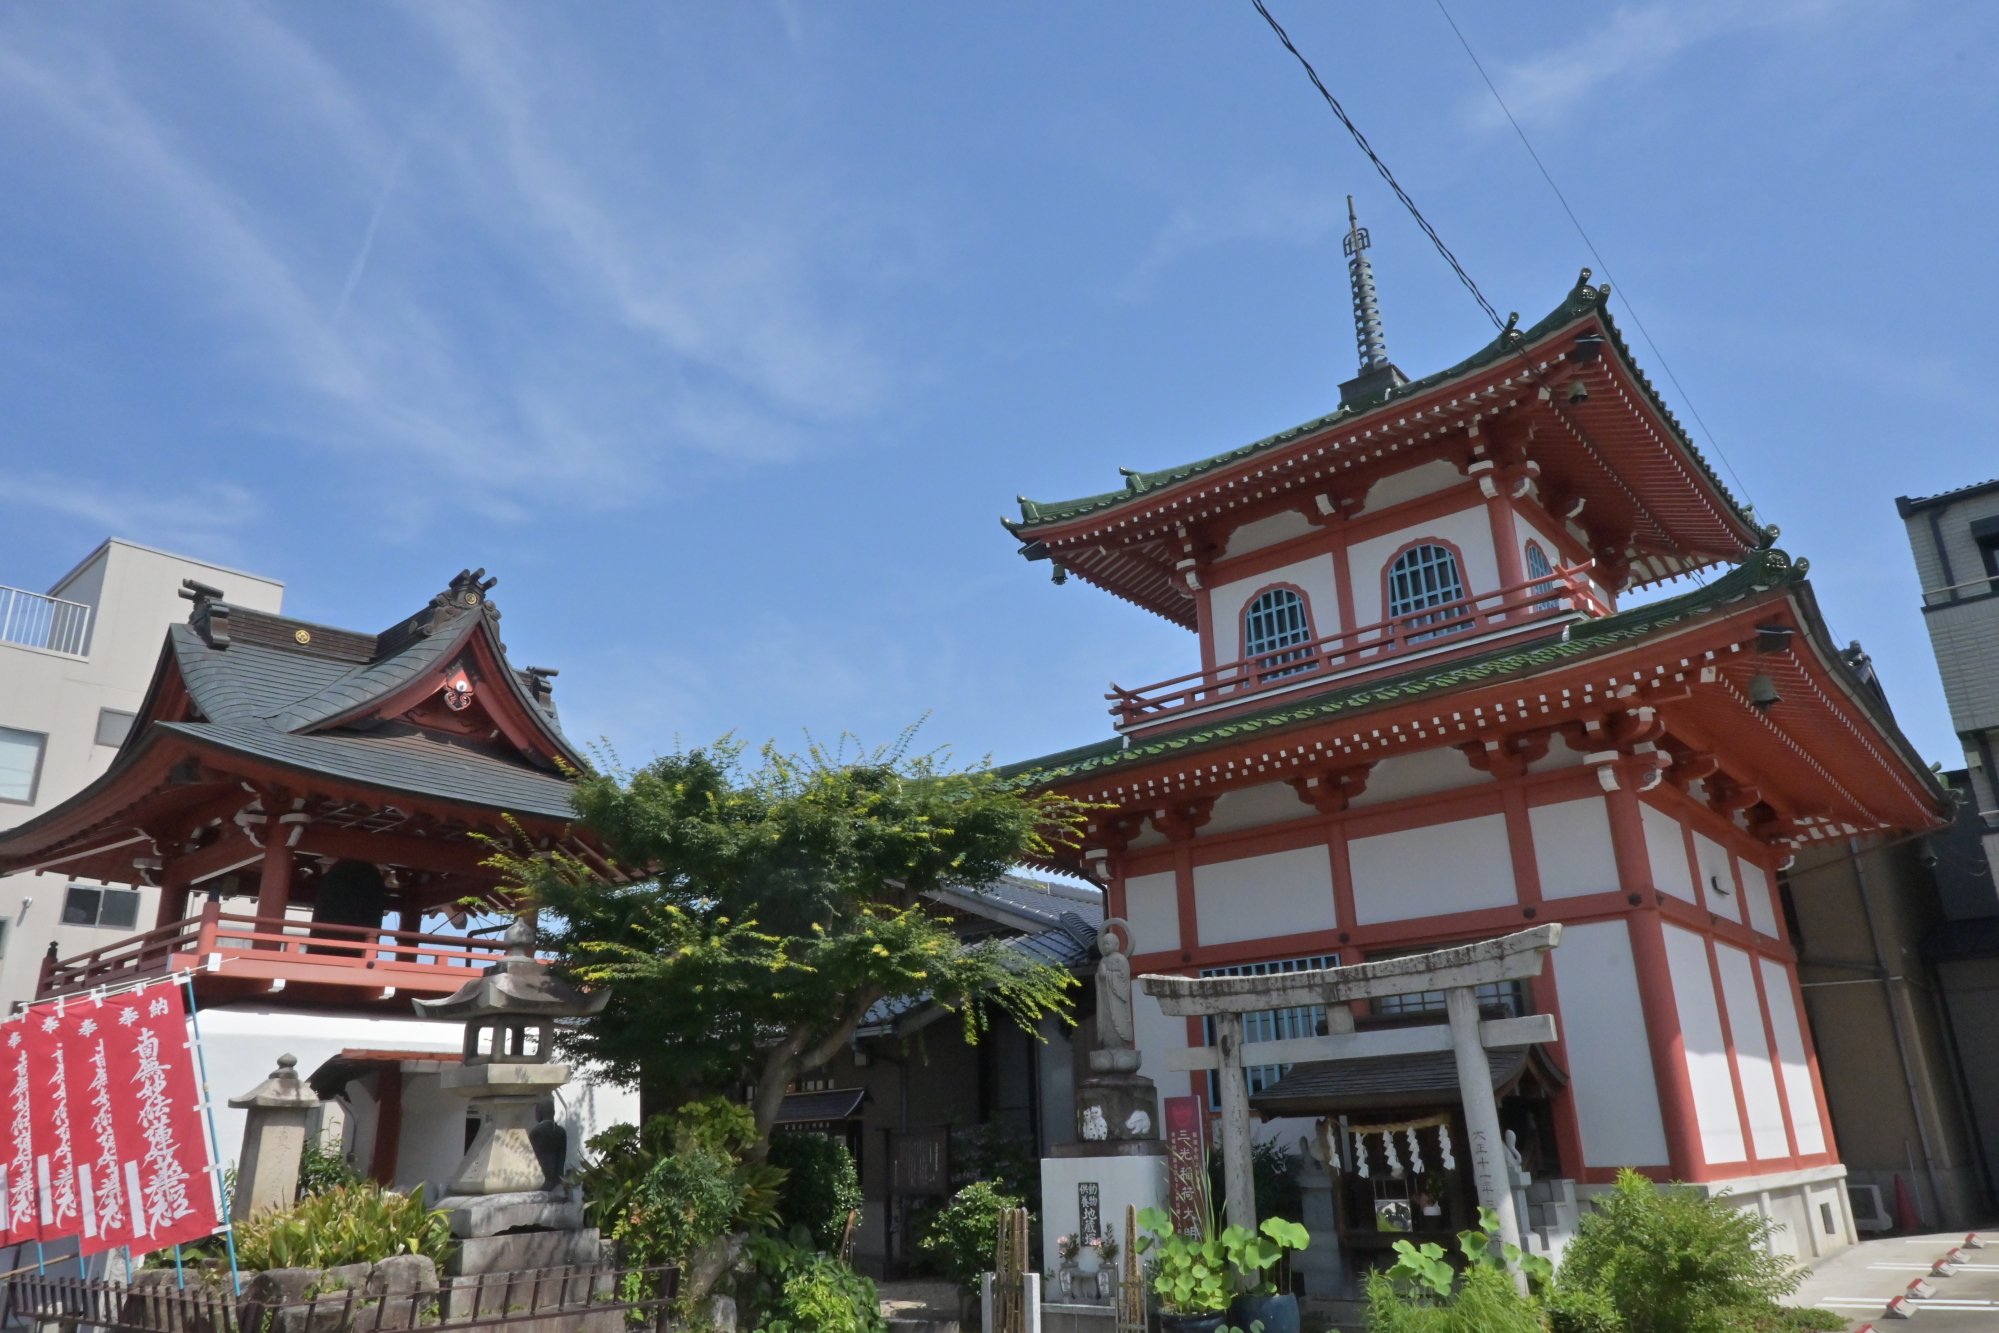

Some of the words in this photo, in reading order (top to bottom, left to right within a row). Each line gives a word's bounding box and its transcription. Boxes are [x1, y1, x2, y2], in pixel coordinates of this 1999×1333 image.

[118, 996, 169, 1028] 奉納
[41, 1015, 59, 1034] 奉
[78, 1018, 97, 1038] 奉
